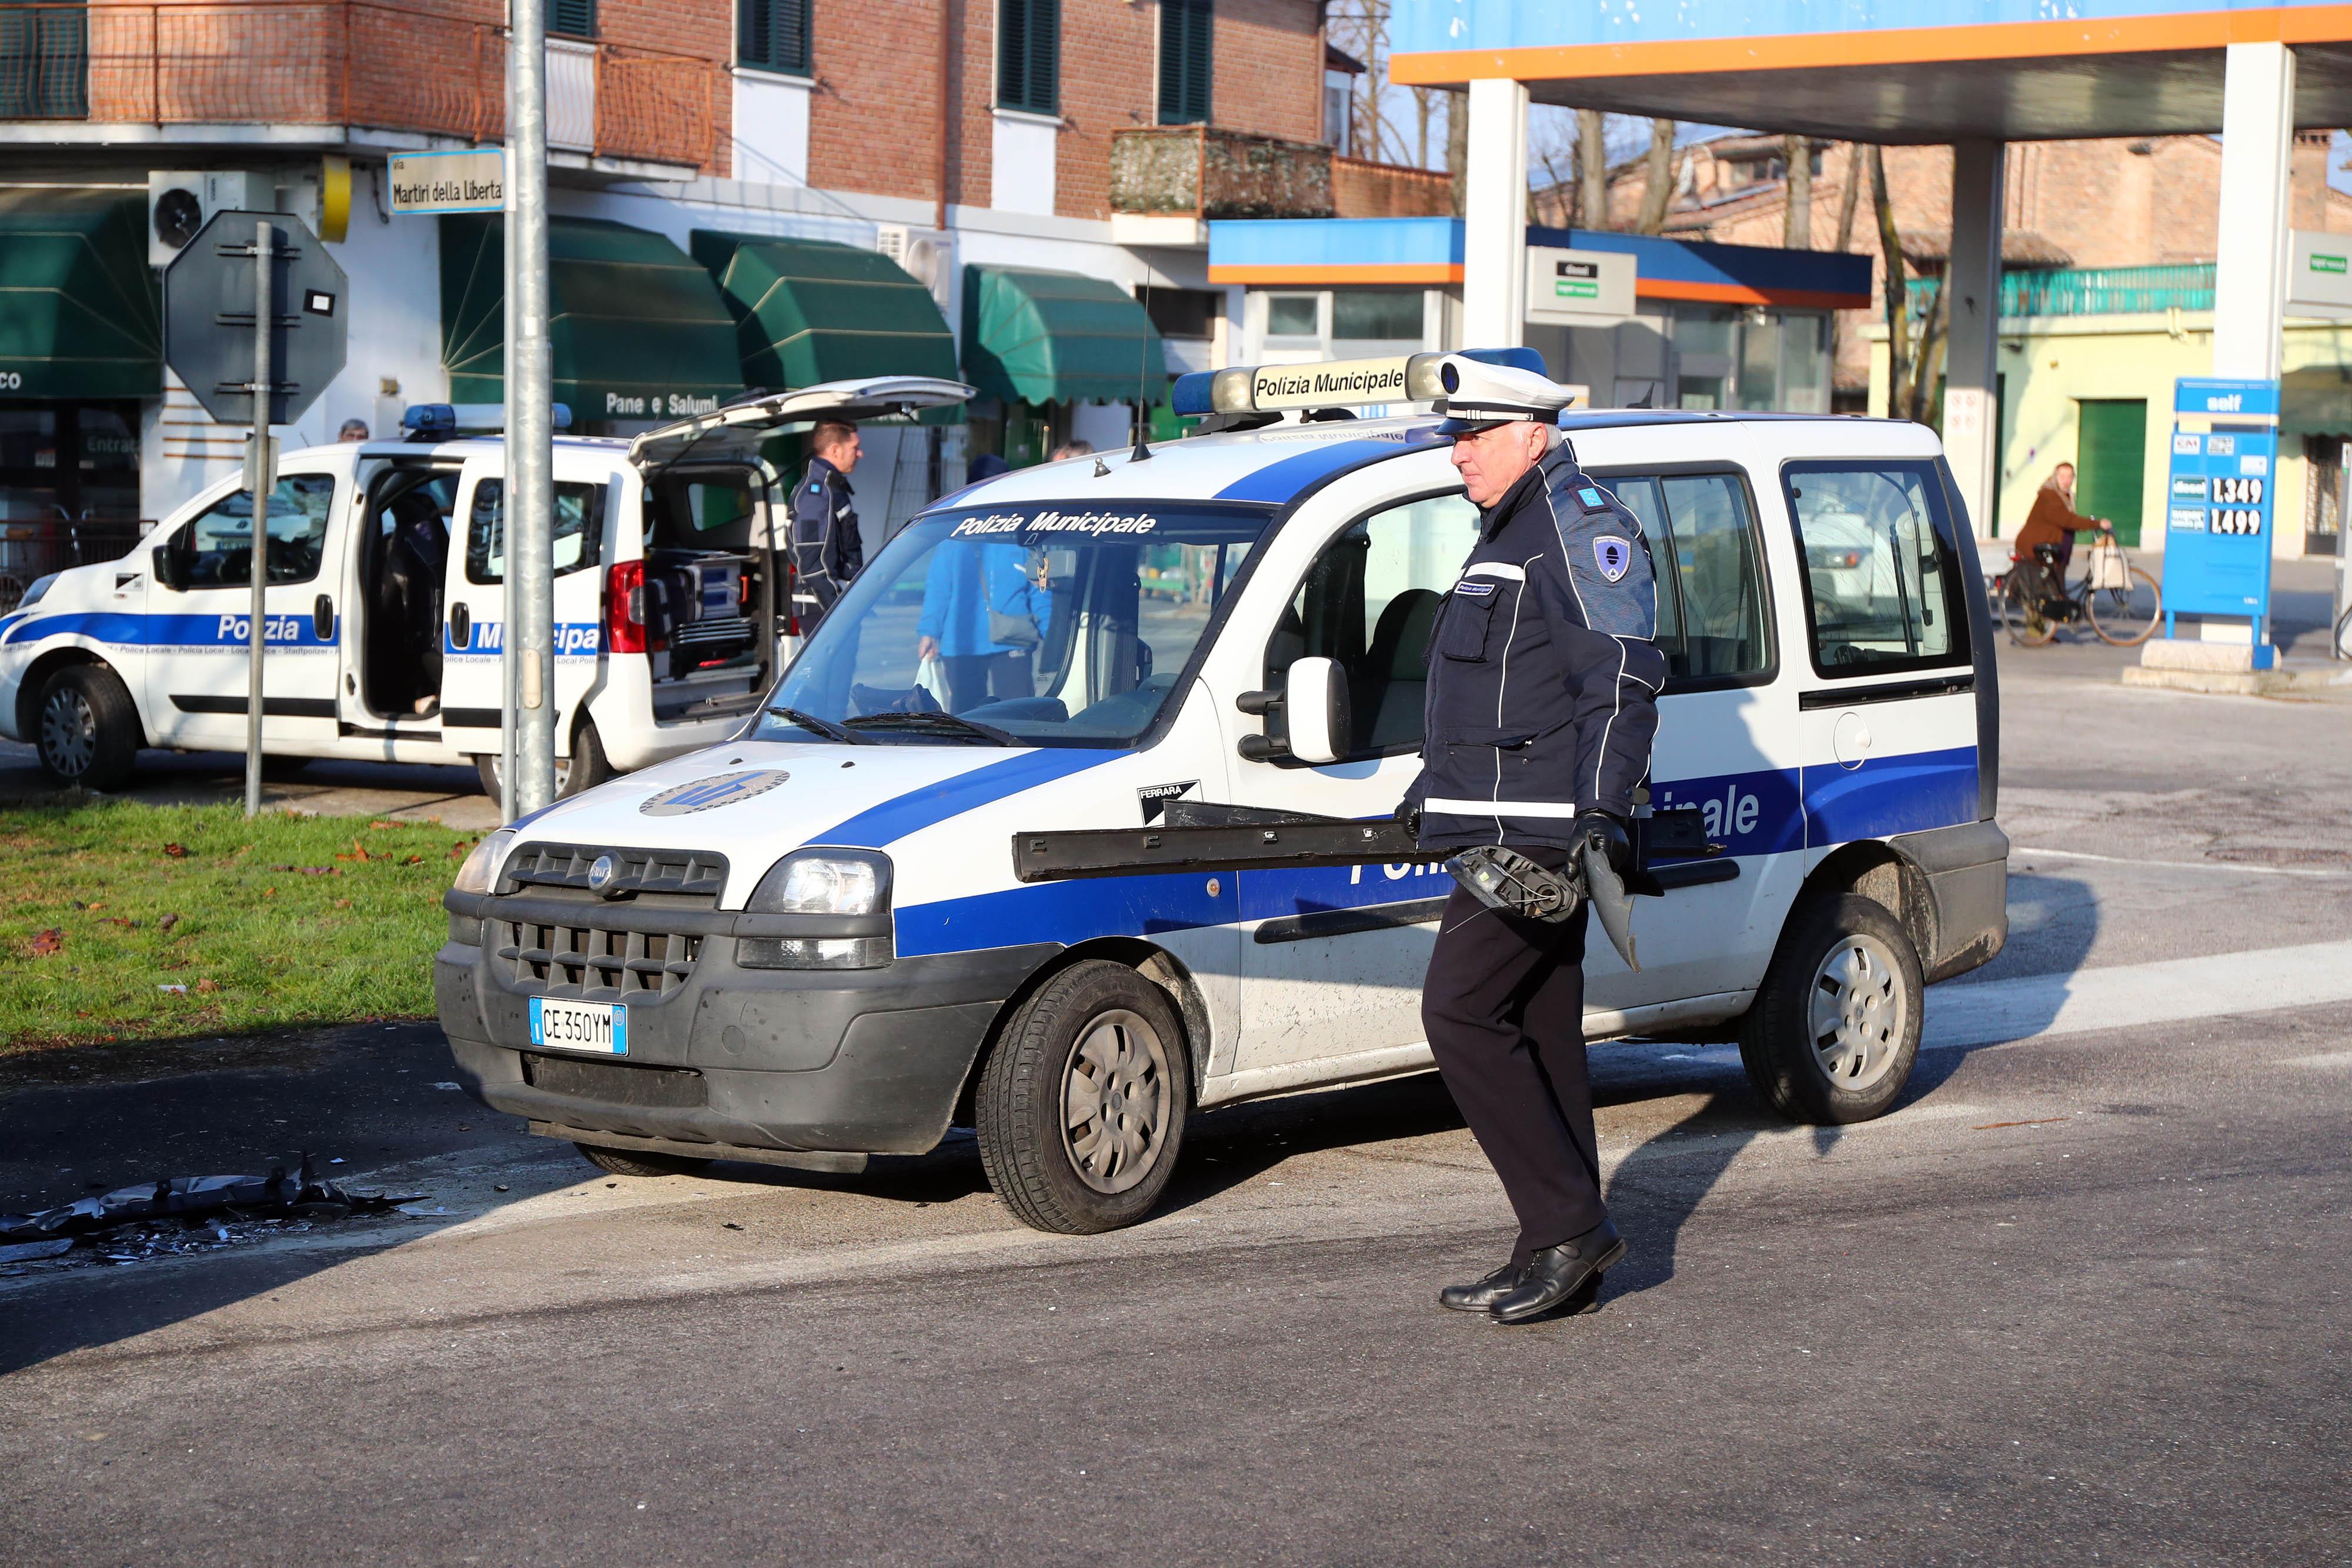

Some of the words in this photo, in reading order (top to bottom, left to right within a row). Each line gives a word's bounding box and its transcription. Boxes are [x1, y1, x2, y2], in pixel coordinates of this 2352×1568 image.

[393, 159, 405, 169] via
[393, 183, 429, 203] Martiri
[432, 181, 460, 201] della
[1256, 376, 1310, 397] Polizia
[1314, 369, 1404, 394] Municipale
[606, 392, 644, 414] Pane
[652, 396, 662, 414] e
[669, 393, 719, 415] Salumi
[2207, 393, 2243, 412] self
[2213, 477, 2263, 504] 1,349
[950, 513, 1025, 537] Polizia
[1025, 511, 1157, 537] Municipale
[2211, 508, 2261, 536] 1,499
[218, 615, 300, 640] Pozia
[1140, 785, 1182, 799] FERRARA
